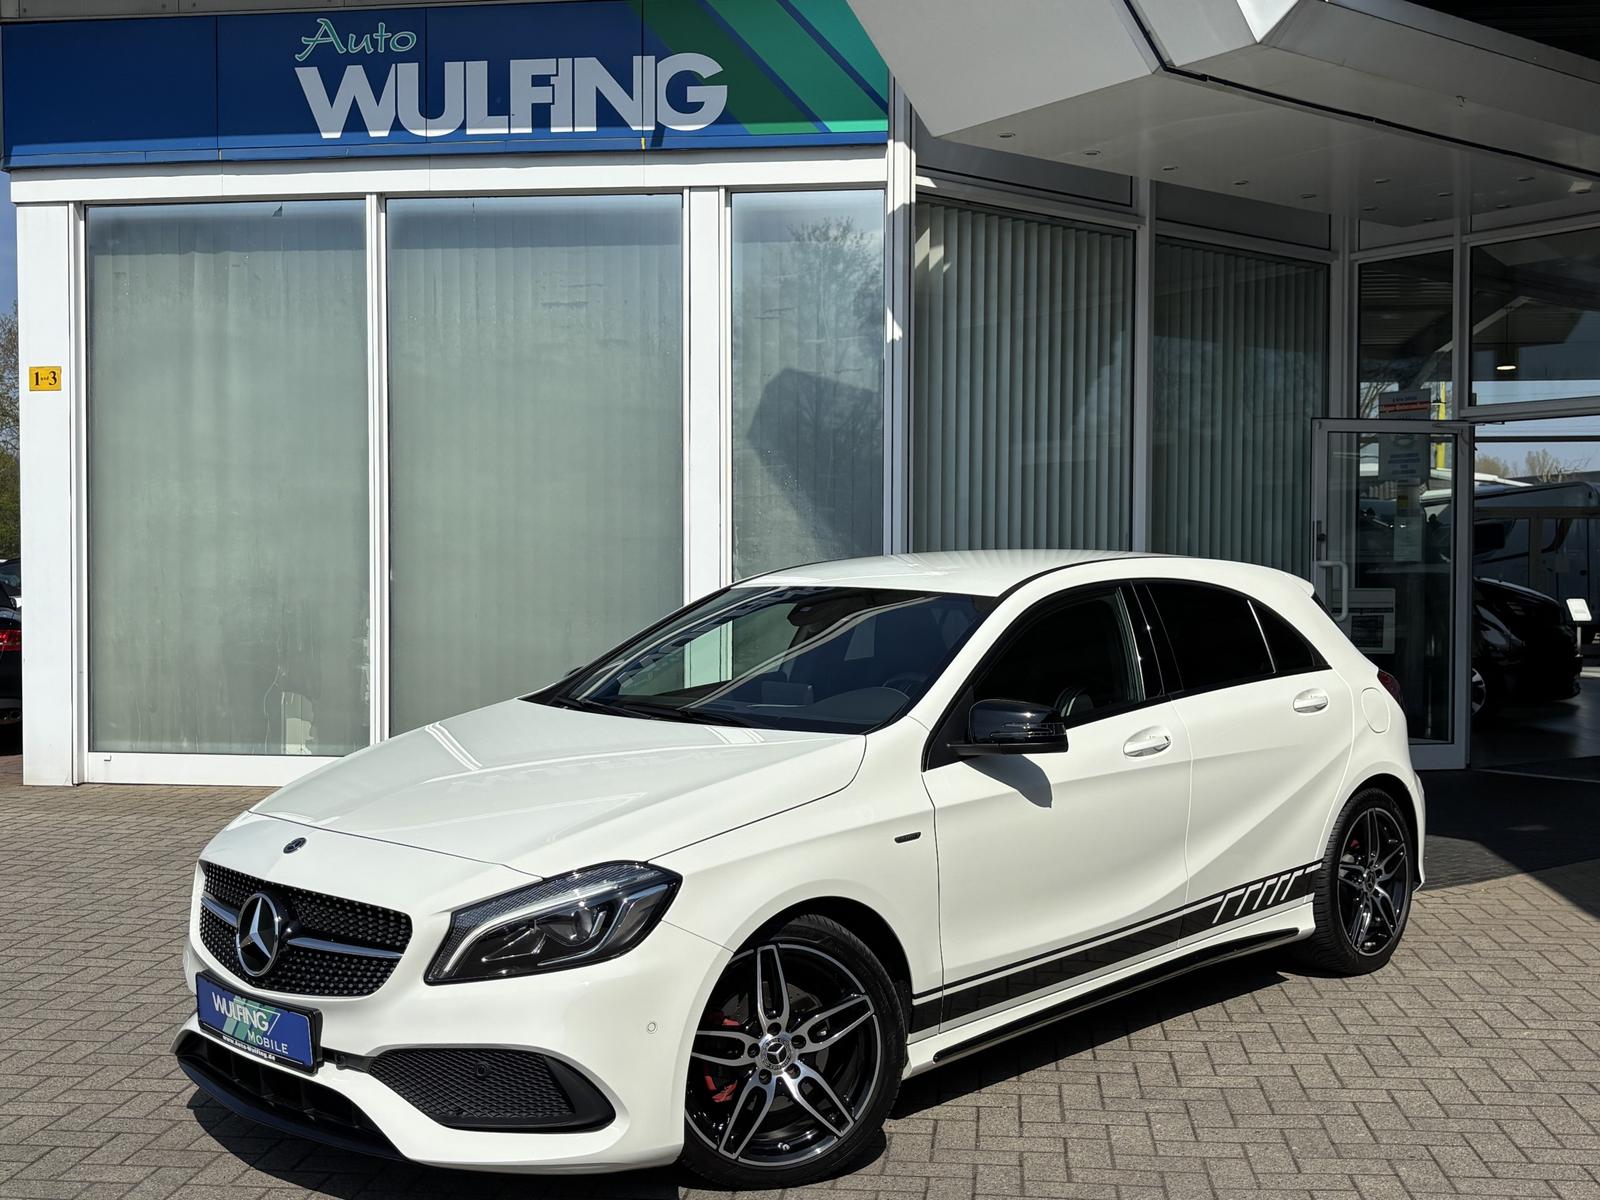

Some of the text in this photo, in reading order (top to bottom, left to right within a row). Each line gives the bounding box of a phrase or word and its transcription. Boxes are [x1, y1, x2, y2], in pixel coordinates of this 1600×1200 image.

[294, 17, 418, 61] Auto
[294, 52, 729, 140] WULFING
[34, 371, 40, 386] 1
[49, 370, 57, 386] 3
[211, 991, 269, 1032] WULFING
